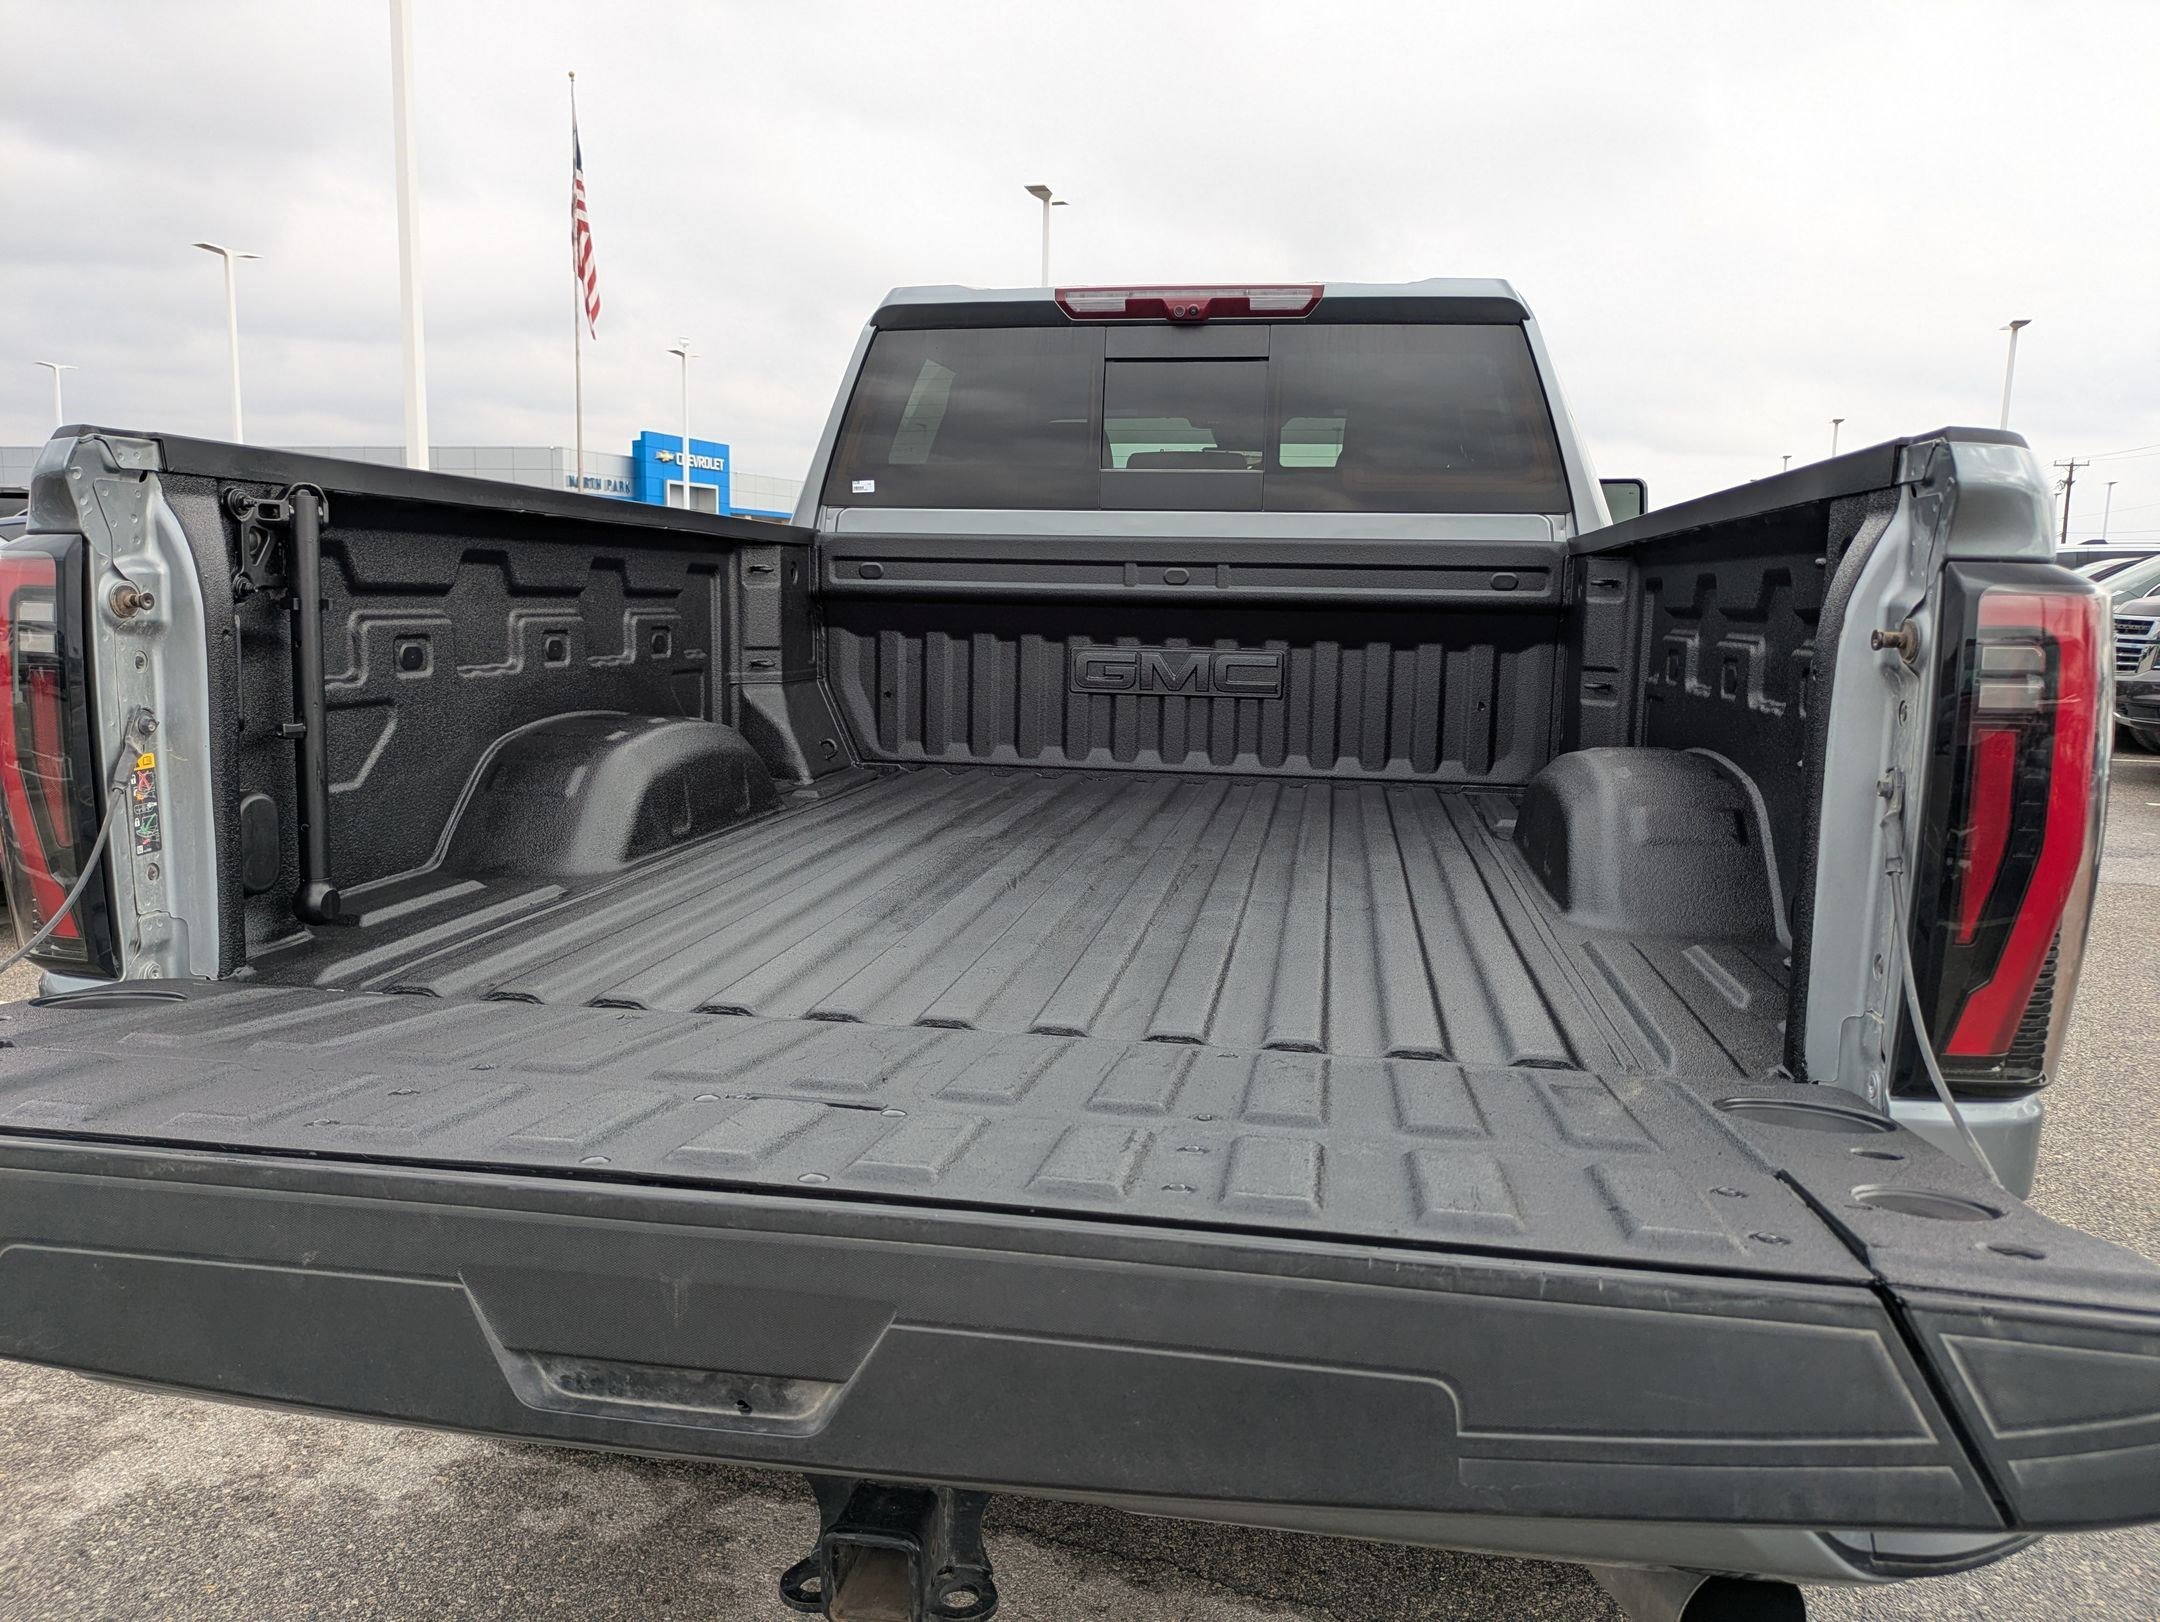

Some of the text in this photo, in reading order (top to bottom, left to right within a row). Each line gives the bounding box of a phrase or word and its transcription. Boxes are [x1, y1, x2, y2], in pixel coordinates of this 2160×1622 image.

[676, 452, 724, 471] CEVROLET
[604, 478, 631, 494] PARK
[1074, 651, 1279, 694] GMC
